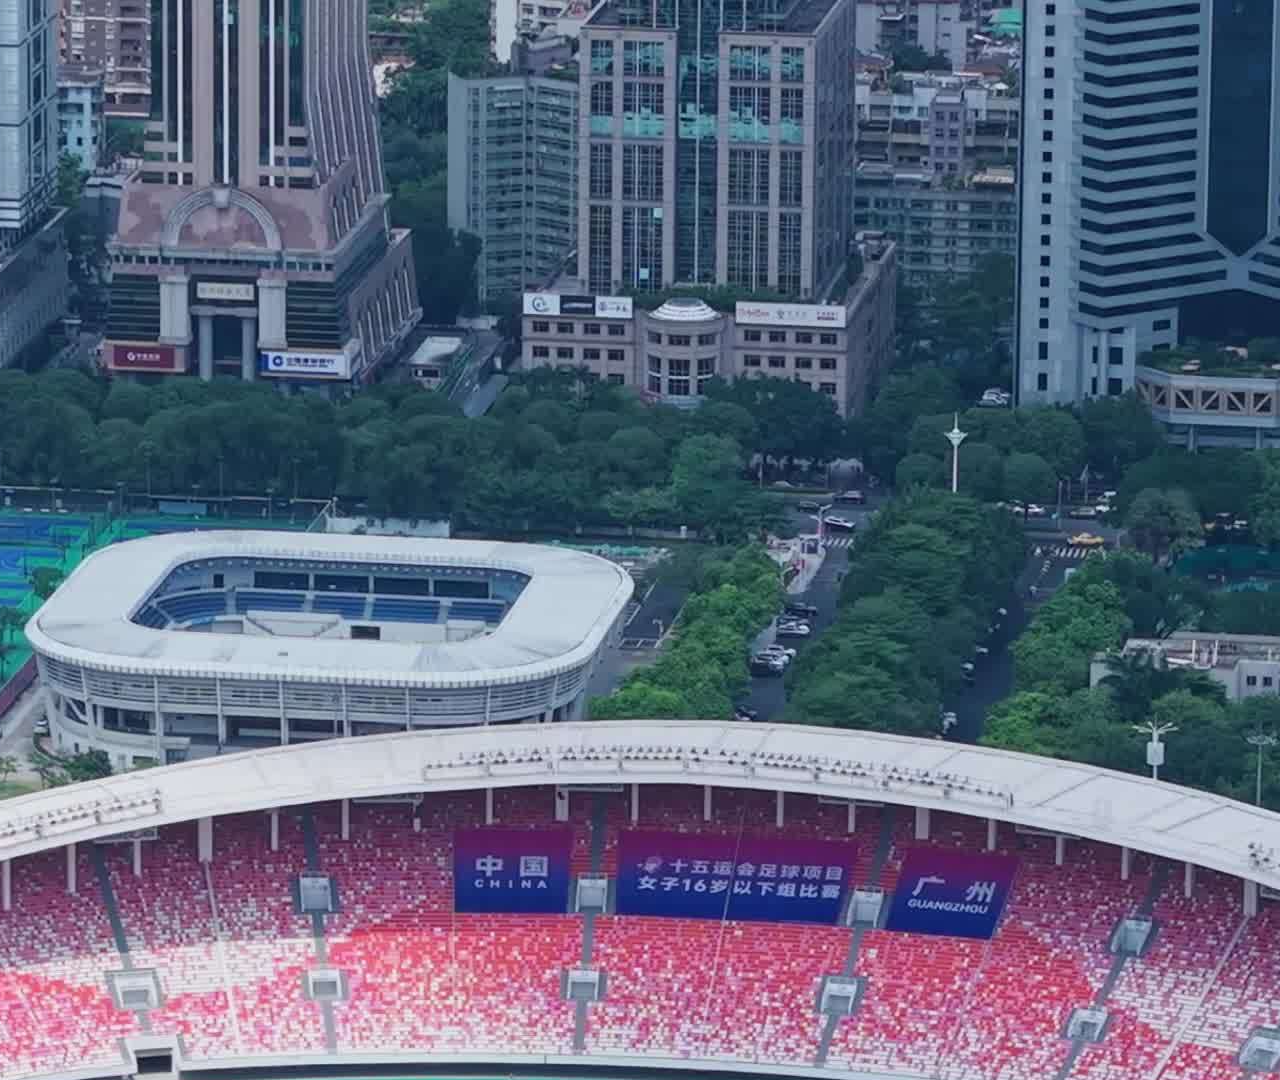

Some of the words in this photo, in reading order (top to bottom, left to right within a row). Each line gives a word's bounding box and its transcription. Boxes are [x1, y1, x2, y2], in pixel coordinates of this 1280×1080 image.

[475, 855, 548, 878] 中国
[670, 859, 843, 881] 十五运会足球项目
[474, 880, 548, 889] CHINA
[639, 876, 841, 899] 女子16岁以下组比赛
[912, 876, 996, 902] 广州
[907, 898, 989, 914] GUANGZHOU
